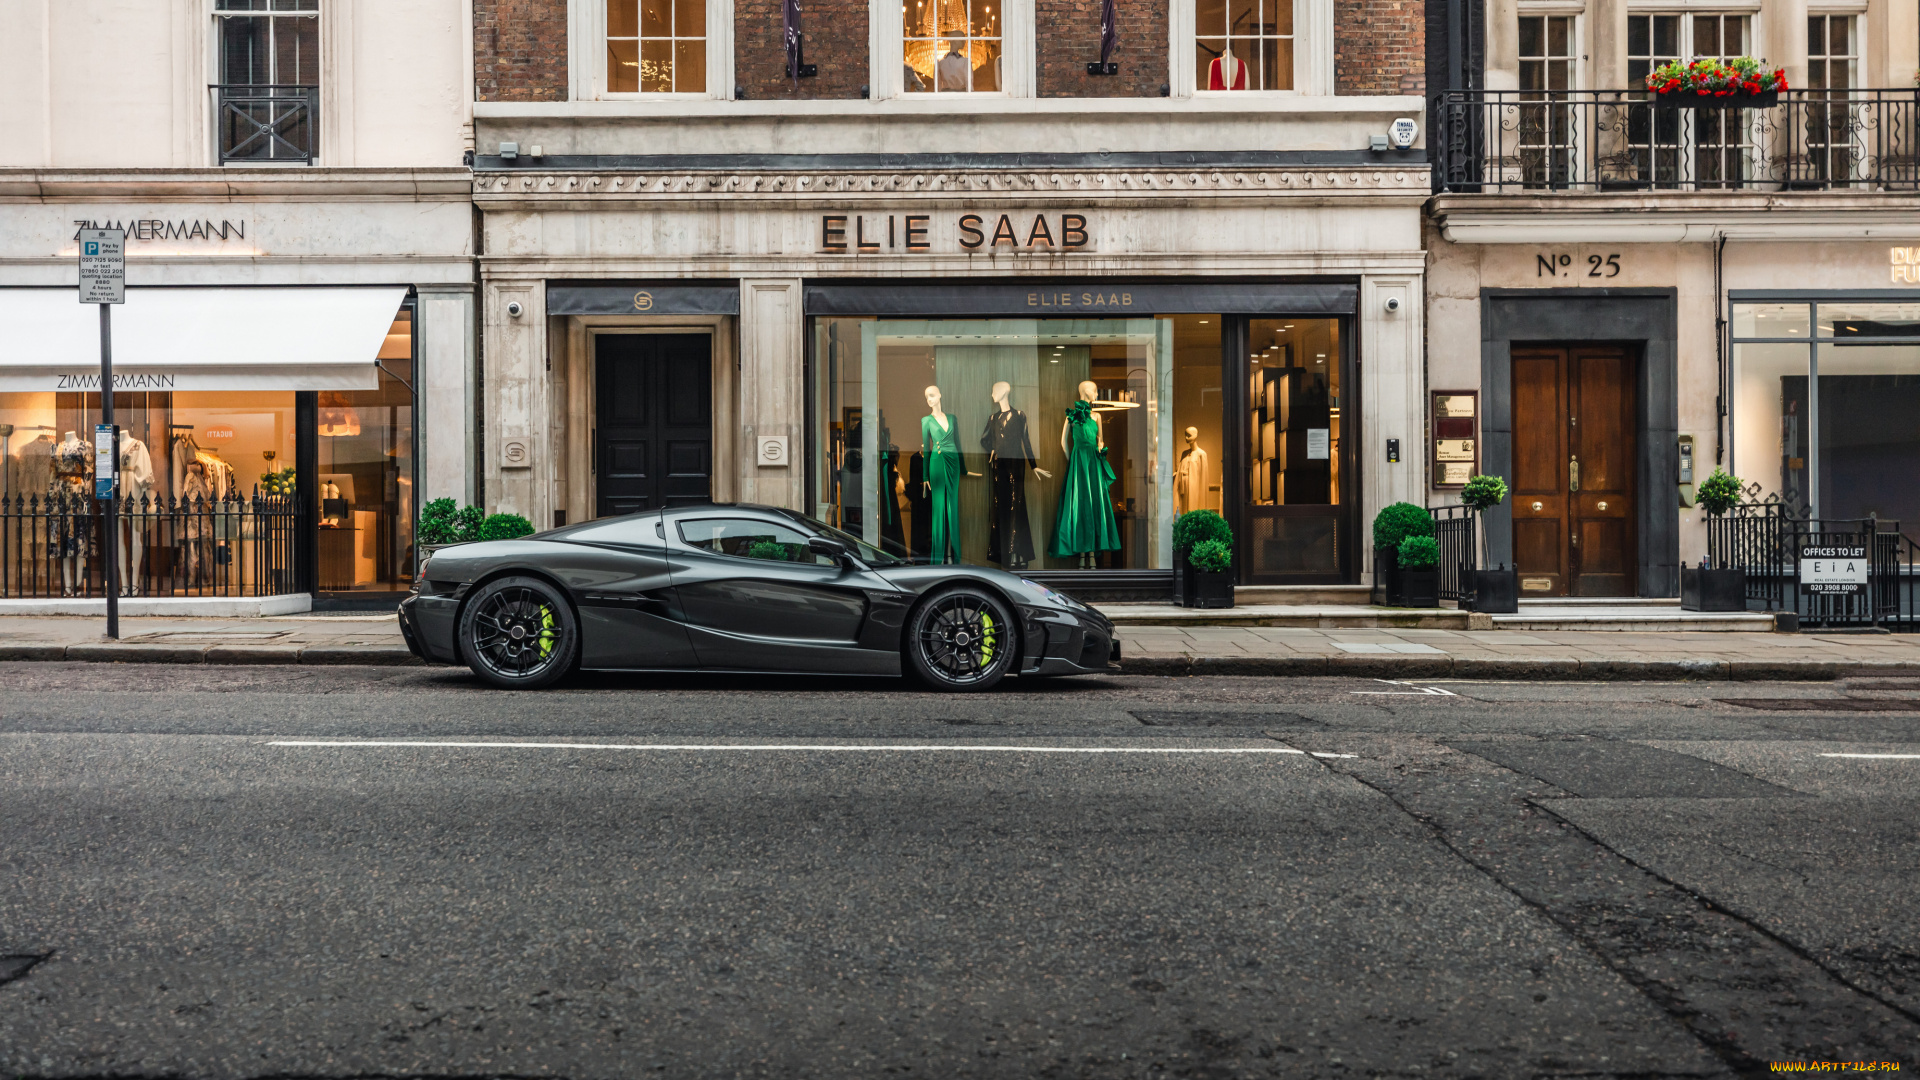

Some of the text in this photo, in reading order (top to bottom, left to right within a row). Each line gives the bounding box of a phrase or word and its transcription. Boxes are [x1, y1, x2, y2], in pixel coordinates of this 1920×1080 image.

[822, 213, 1090, 249] ELIE SAAB
[88, 243, 97, 254] P
[1588, 254, 1621, 278] 25
[1891, 265, 1920, 283] FU
[1027, 293, 1133, 306] ELIE SAAB
[57, 374, 175, 388] ZIMMRMANN
[1803, 548, 1864, 556] OFFICES TO LET
